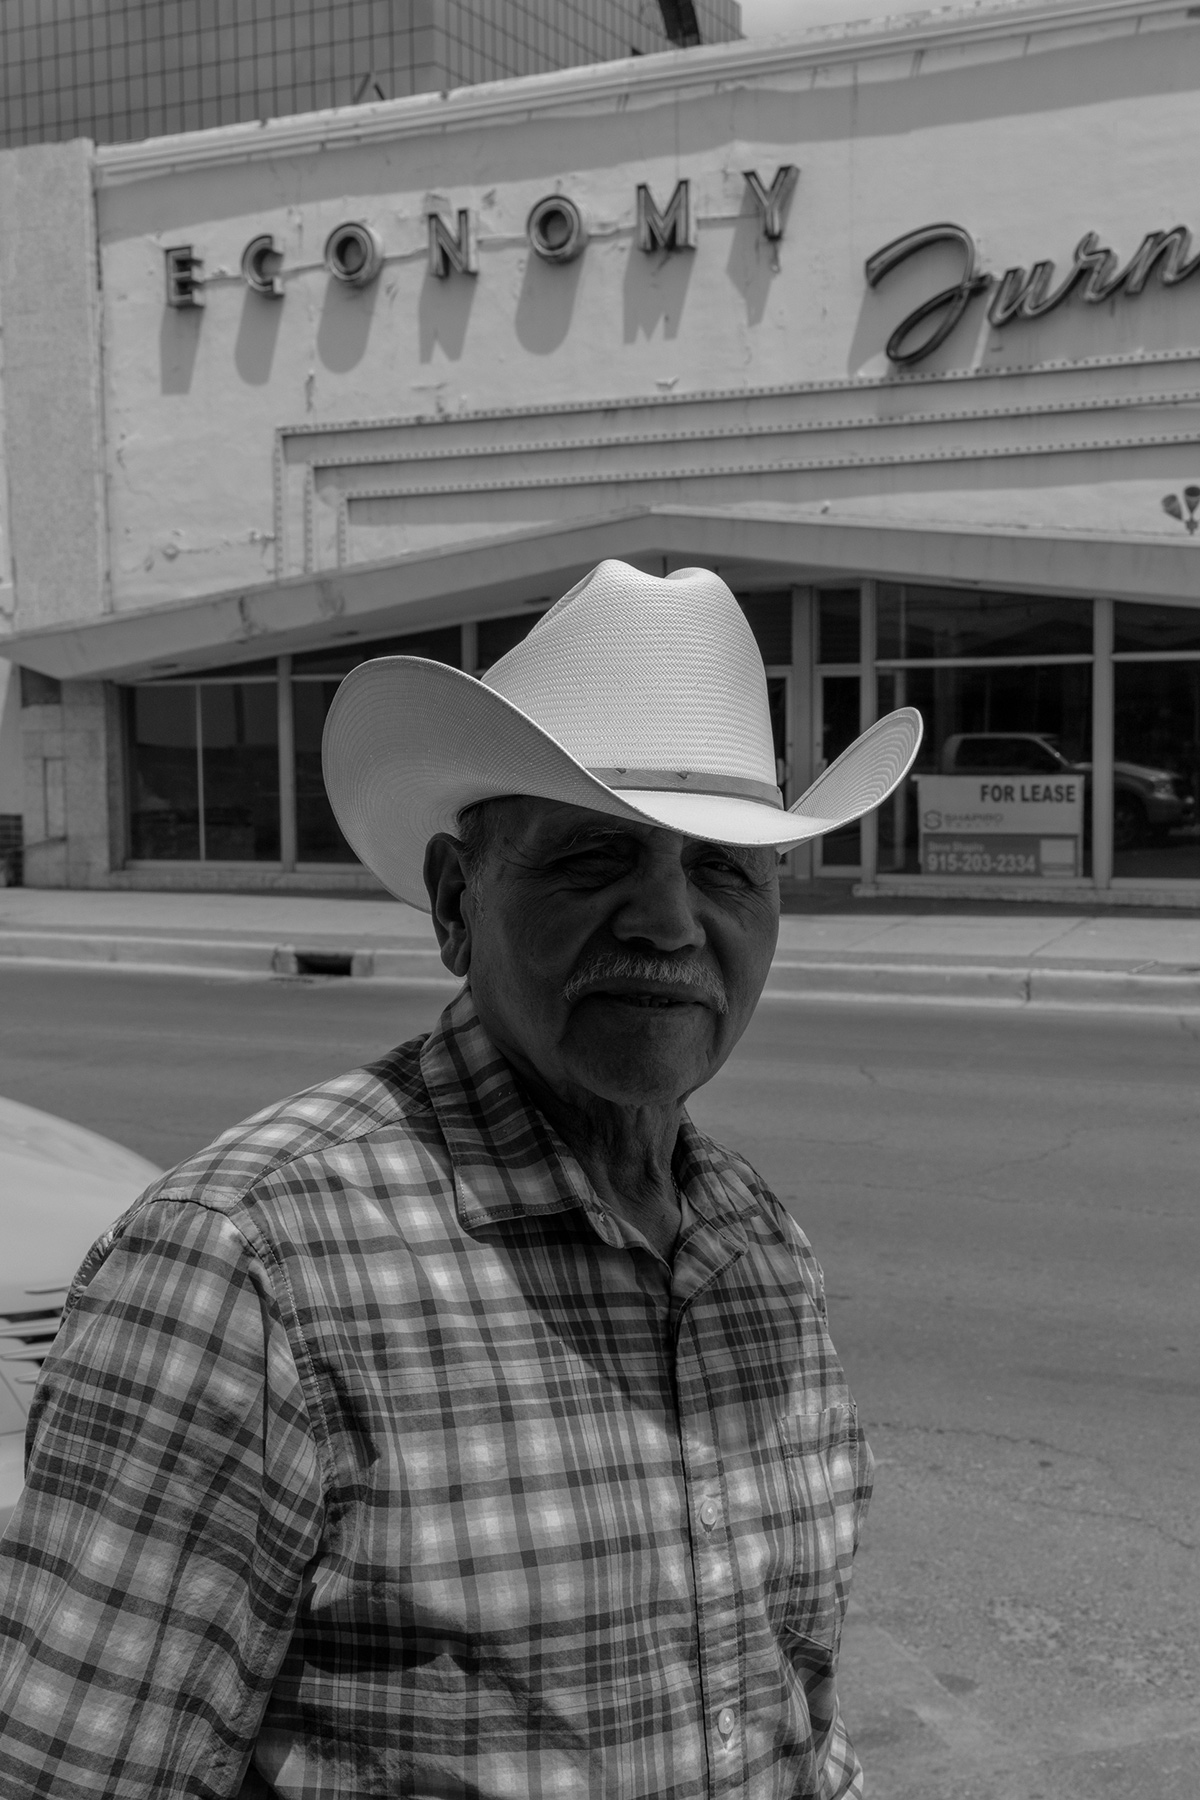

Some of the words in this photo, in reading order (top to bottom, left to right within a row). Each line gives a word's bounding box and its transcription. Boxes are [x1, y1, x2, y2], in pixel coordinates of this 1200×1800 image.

[165, 165, 800, 308] ECONOMY
[980, 784, 1015, 802] FOR
[1021, 784, 1076, 802] LEASE
